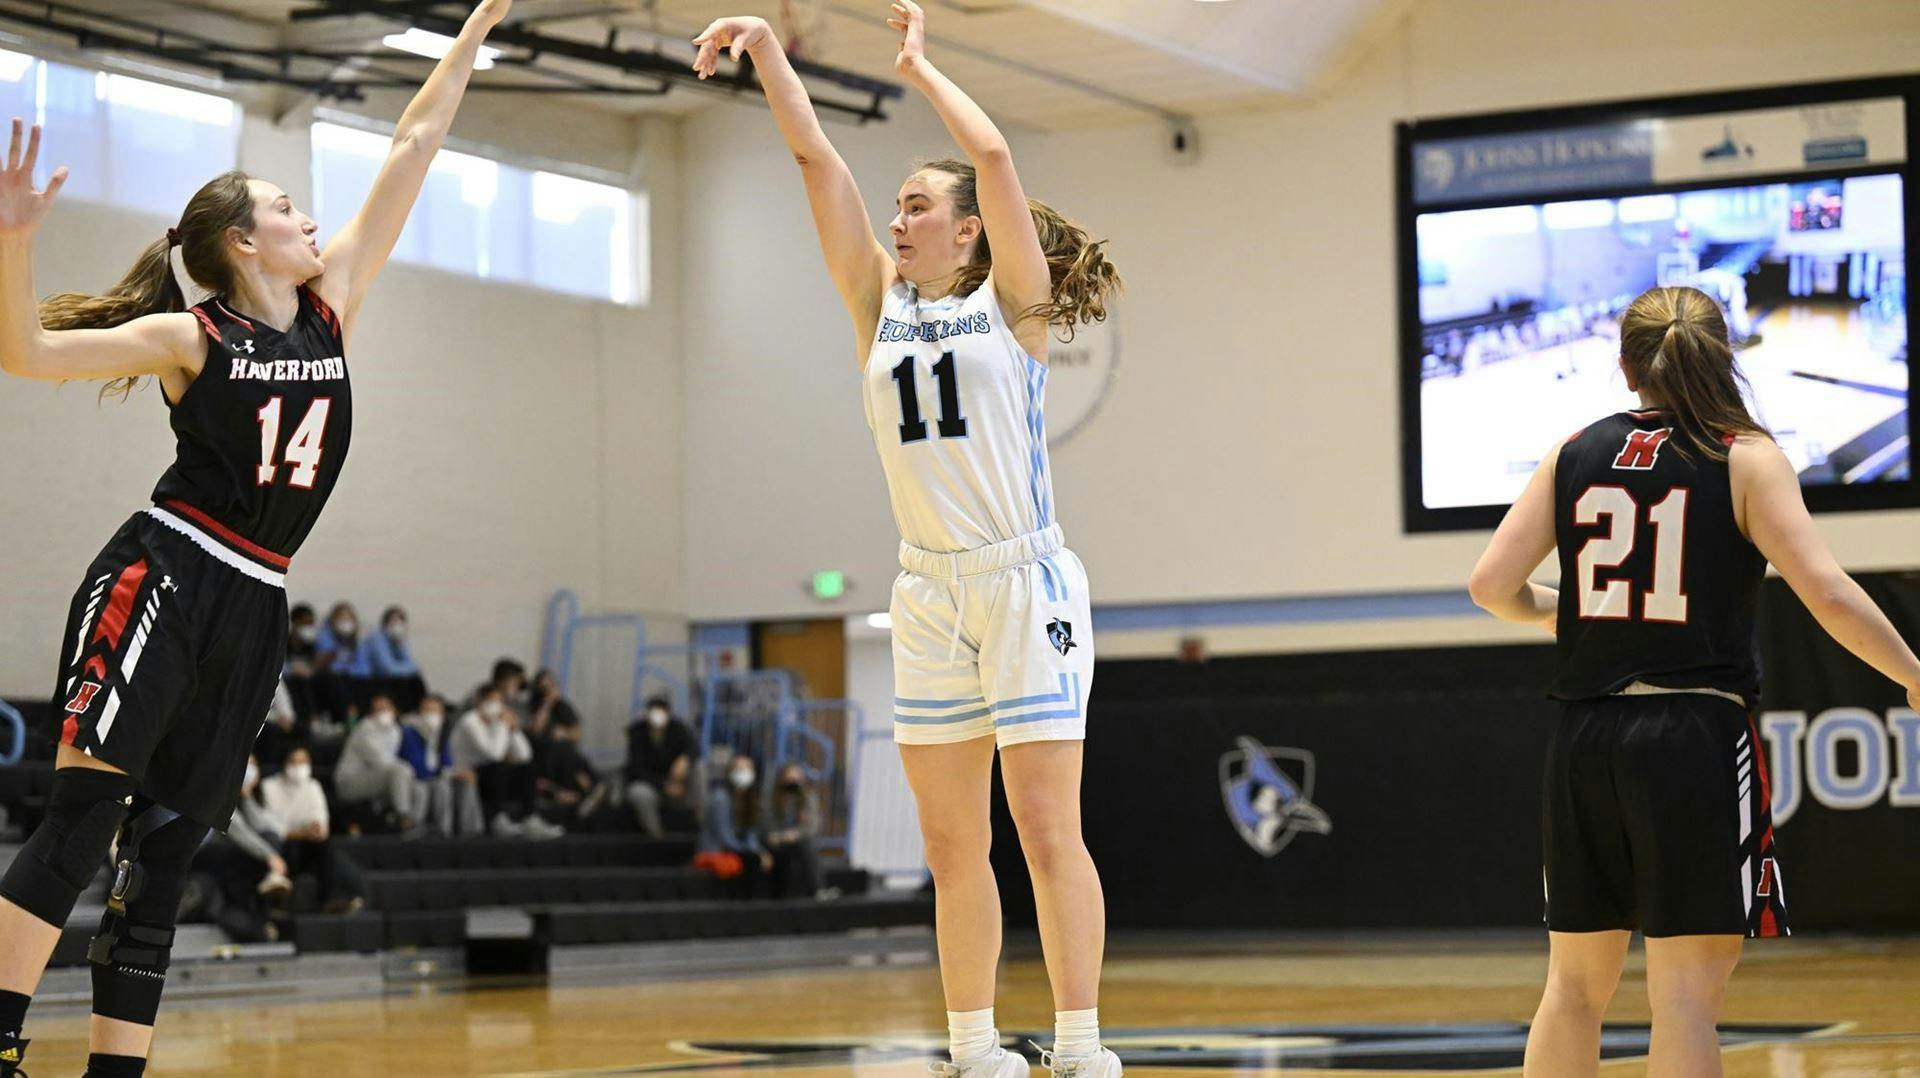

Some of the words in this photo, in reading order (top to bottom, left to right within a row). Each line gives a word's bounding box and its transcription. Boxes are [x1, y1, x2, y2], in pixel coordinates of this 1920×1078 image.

[229, 356, 345, 381] HAVERFORD
[891, 349, 970, 446] 11
[256, 394, 333, 490] 14
[1573, 483, 1690, 624] 21
